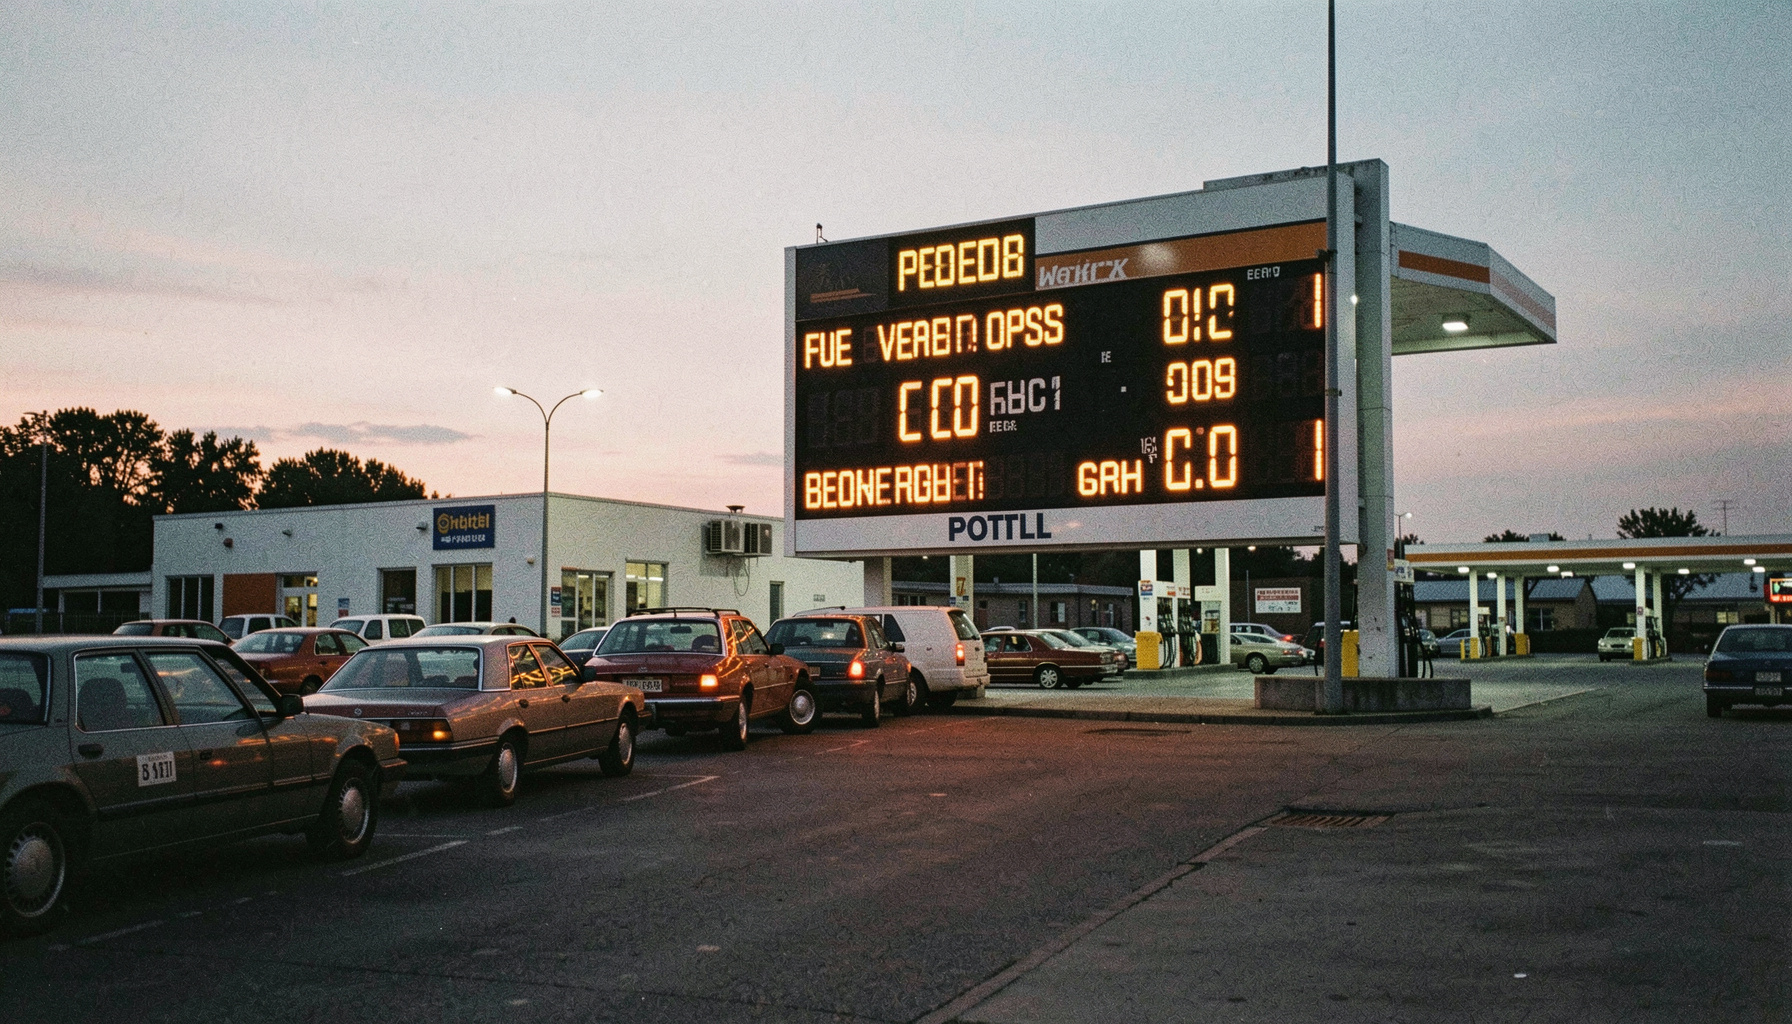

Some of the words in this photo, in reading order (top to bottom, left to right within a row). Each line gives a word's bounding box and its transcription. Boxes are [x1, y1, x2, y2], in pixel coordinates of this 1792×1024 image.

[804, 329, 852, 369] FUE
[986, 303, 1064, 350] OPSS
[949, 513, 1052, 542] POTTLL
